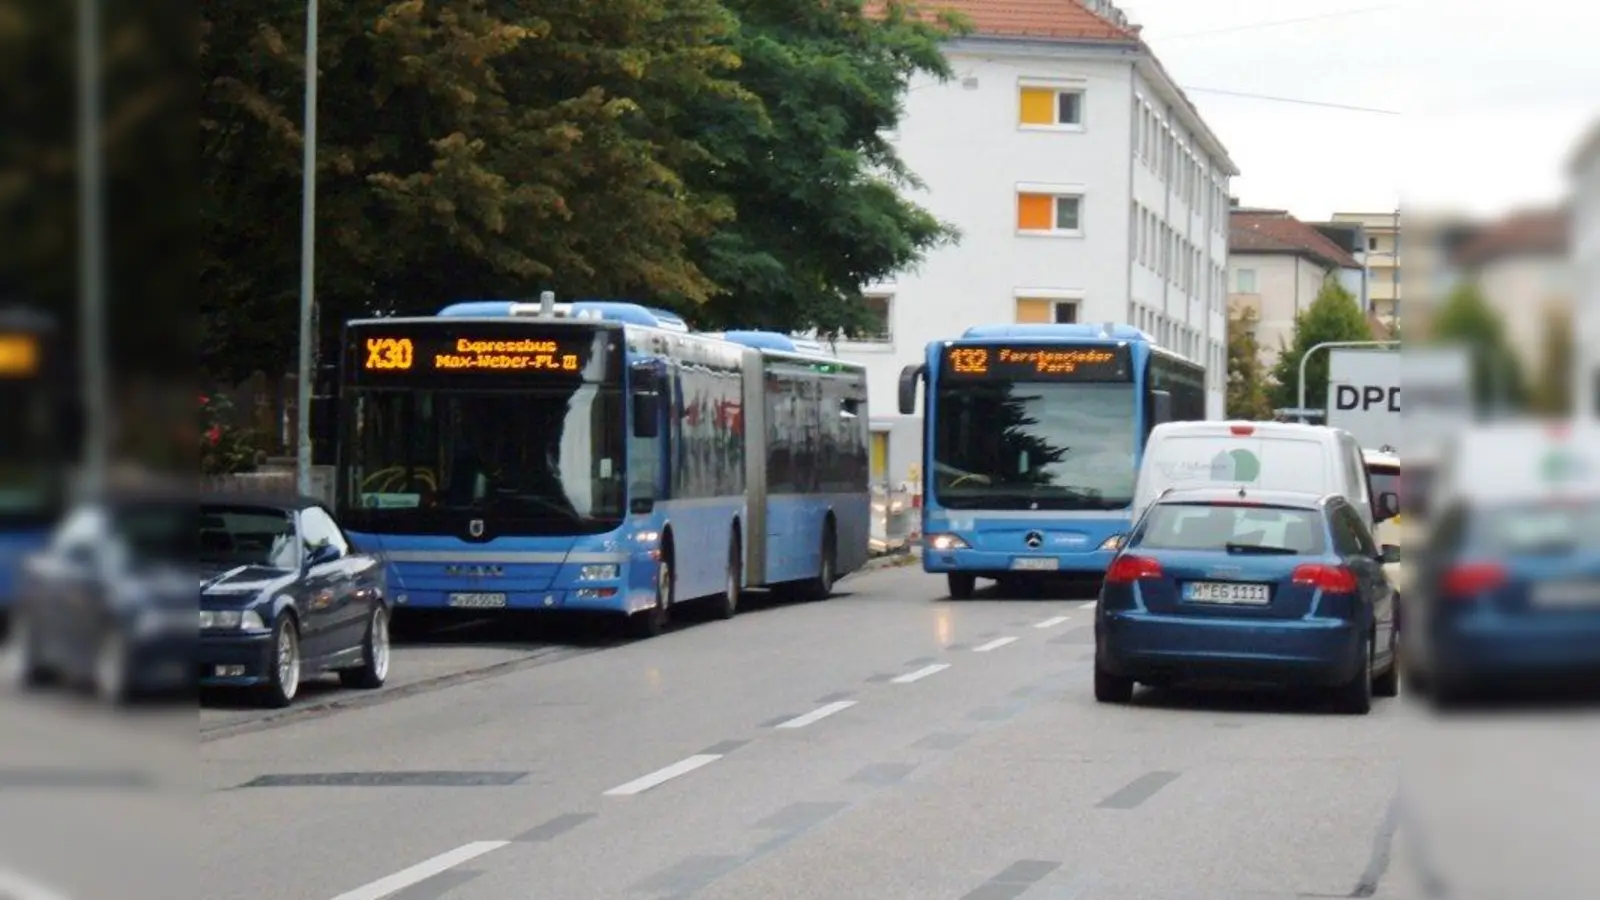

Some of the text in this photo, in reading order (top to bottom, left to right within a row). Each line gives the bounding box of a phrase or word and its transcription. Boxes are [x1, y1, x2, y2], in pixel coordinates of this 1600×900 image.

[365, 338, 414, 369] X30
[456, 338, 558, 353] Expressbus
[435, 354, 560, 369] Max-Weber-Pl.
[950, 349, 988, 373] 132
